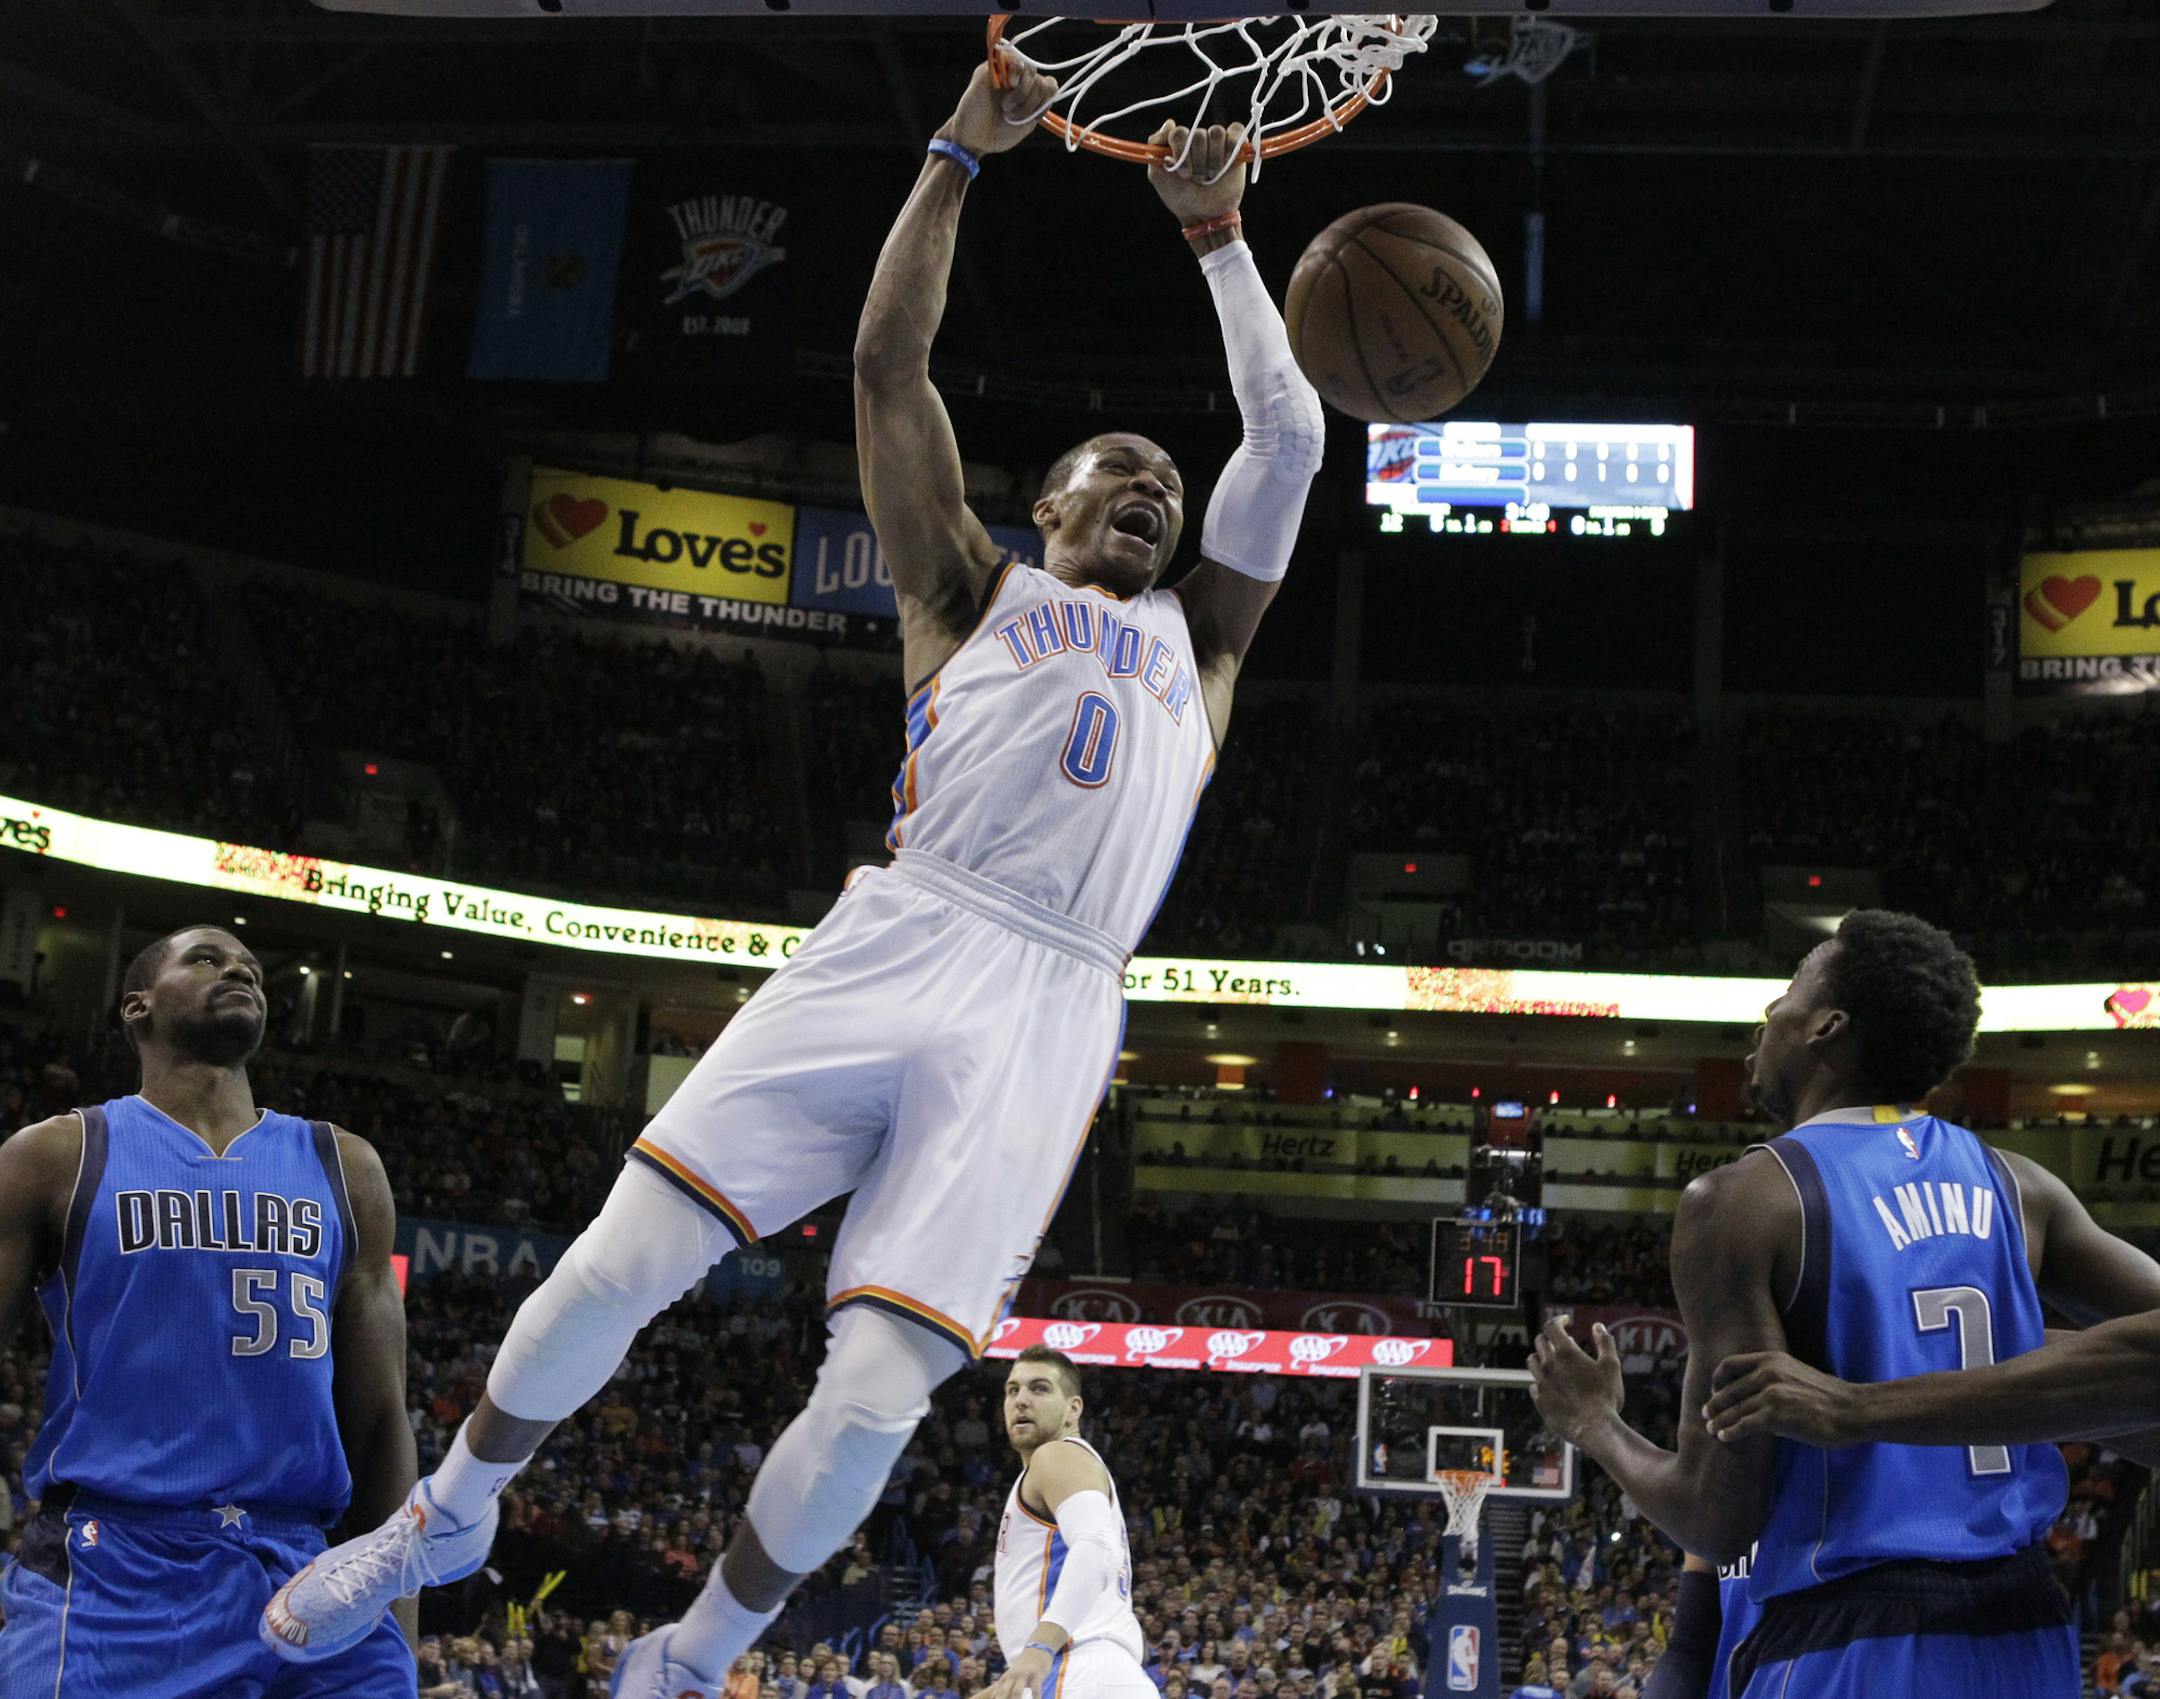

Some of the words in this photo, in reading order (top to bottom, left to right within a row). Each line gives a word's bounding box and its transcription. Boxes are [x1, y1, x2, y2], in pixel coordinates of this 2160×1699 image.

[667, 195, 787, 243] THUNDER
[521, 571, 621, 602] BRING
[627, 586, 691, 616] THE
[697, 596, 848, 633] THUNDER
[994, 599, 1191, 726] THUNDER
[2020, 655, 2122, 681] BRING
[1060, 691, 1121, 790] 0
[304, 868, 431, 922] Bringing
[443, 891, 533, 934] Value,
[545, 910, 736, 954] Convenience
[748, 932, 769, 957] &
[780, 935, 801, 958] C
[1163, 967, 1196, 992] 51
[1208, 969, 1301, 996] Years.
[1262, 1133, 1337, 1157] Hertz
[115, 1189, 322, 1260] DALLAS
[1872, 1181, 1994, 1252] AMINU
[414, 1227, 541, 1279] NRA
[740, 1257, 781, 1278] 109
[1463, 1255, 1503, 1297] 17
[231, 1268, 328, 1360] 55
[1066, 1299, 1124, 1323] KA
[1317, 1310, 1378, 1335] KA
[1617, 1325, 1676, 1353] KIA
[1911, 1286, 2011, 1475] 7
